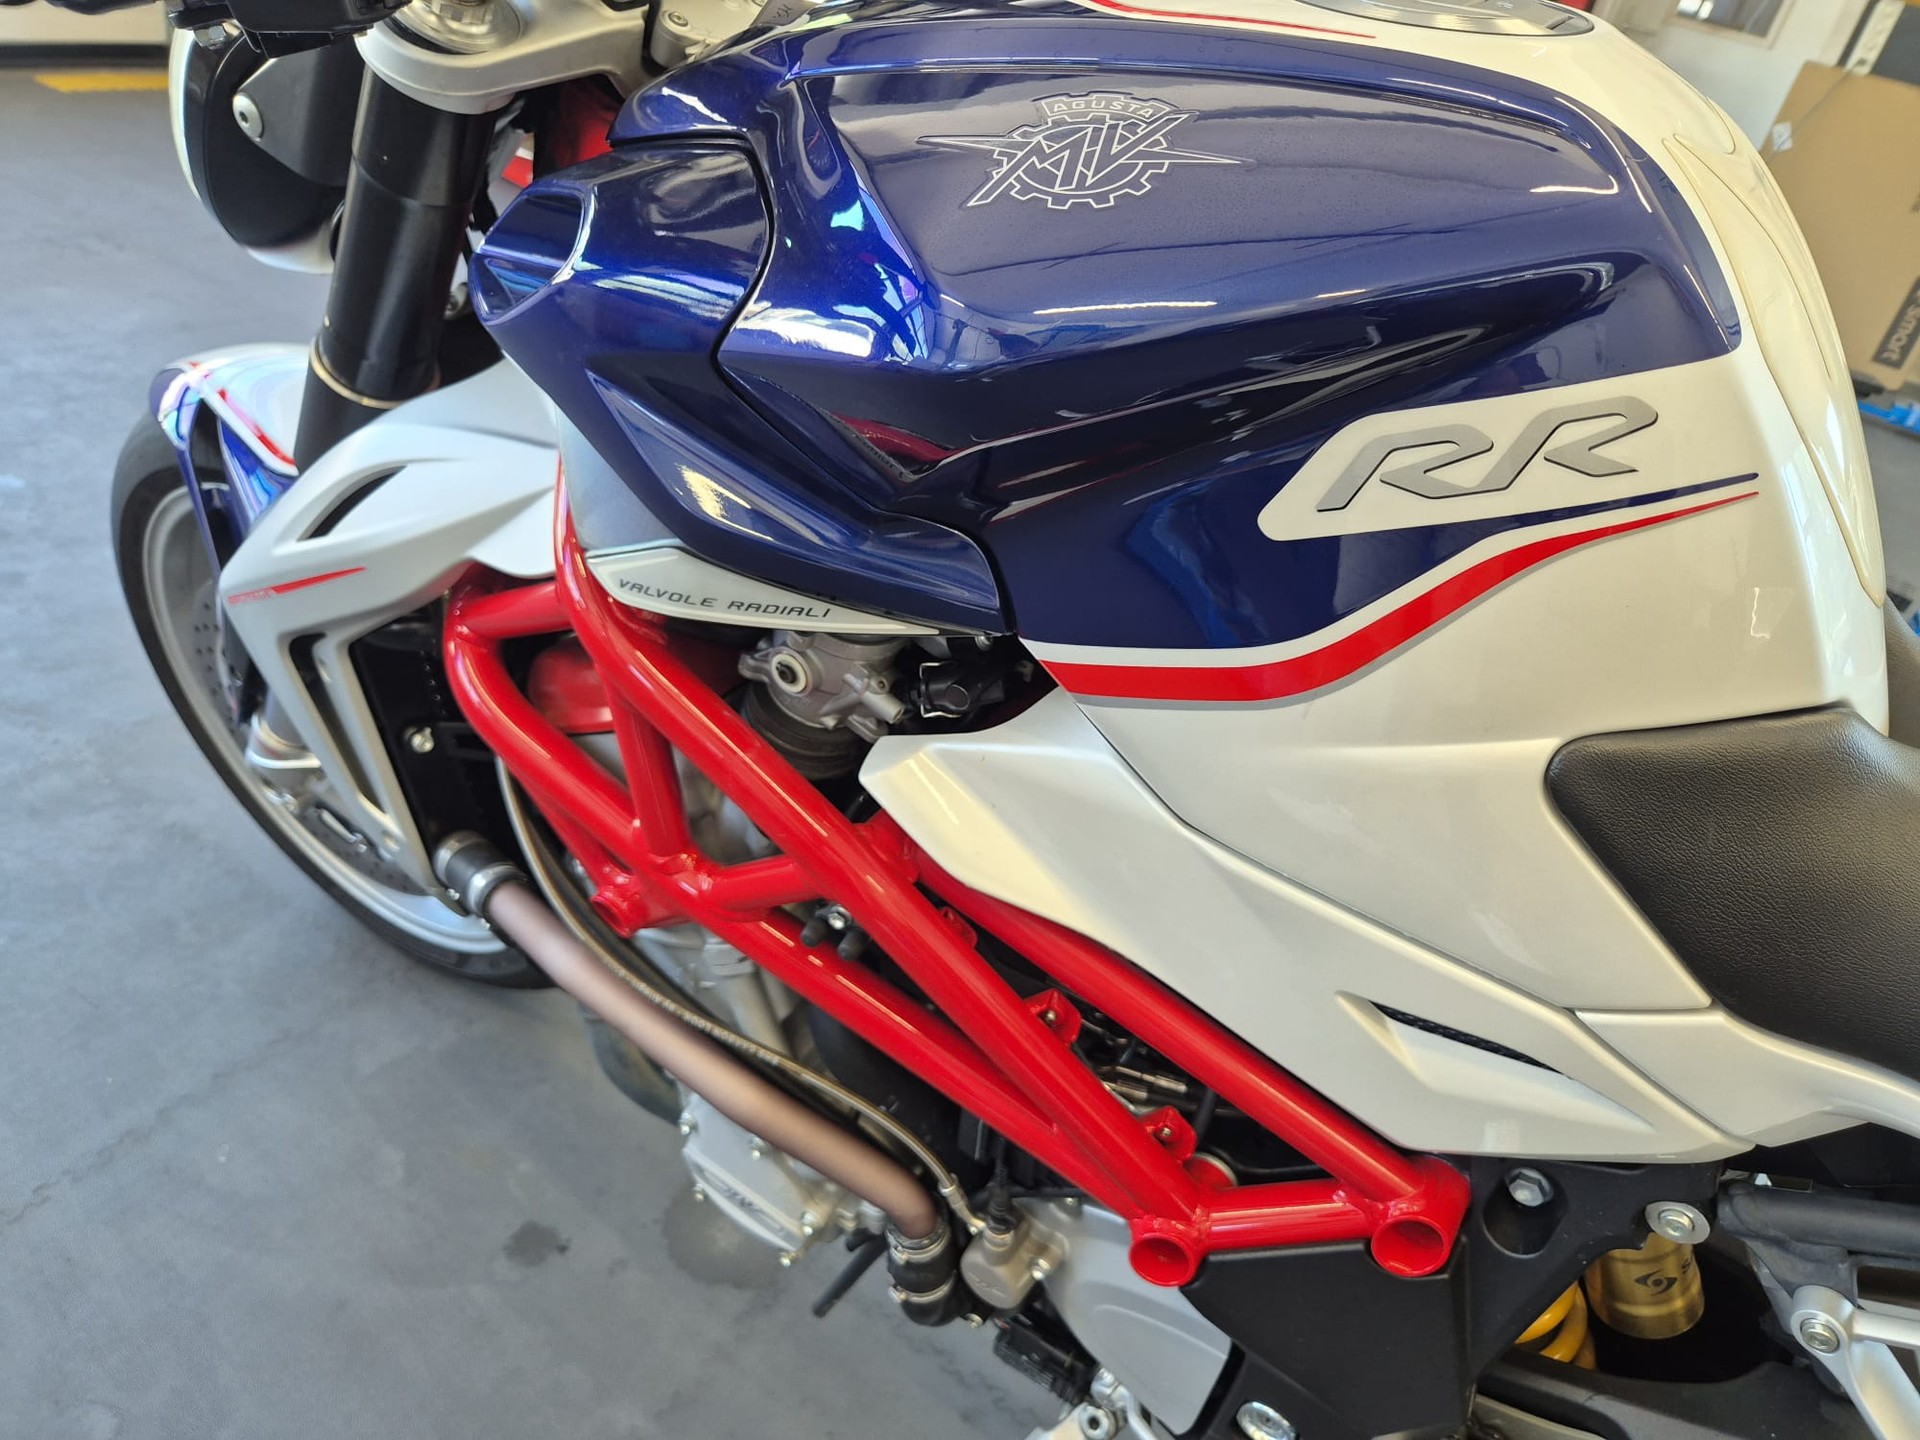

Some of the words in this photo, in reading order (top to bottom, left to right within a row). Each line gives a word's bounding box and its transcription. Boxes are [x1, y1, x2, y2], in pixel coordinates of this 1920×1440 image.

[1052, 99, 1156, 119] AGUSTA
[966, 113, 1190, 208] MV
[1315, 395, 1659, 513] RR
[619, 578, 719, 608] VALVOLE
[727, 600, 832, 618] RADIALI
